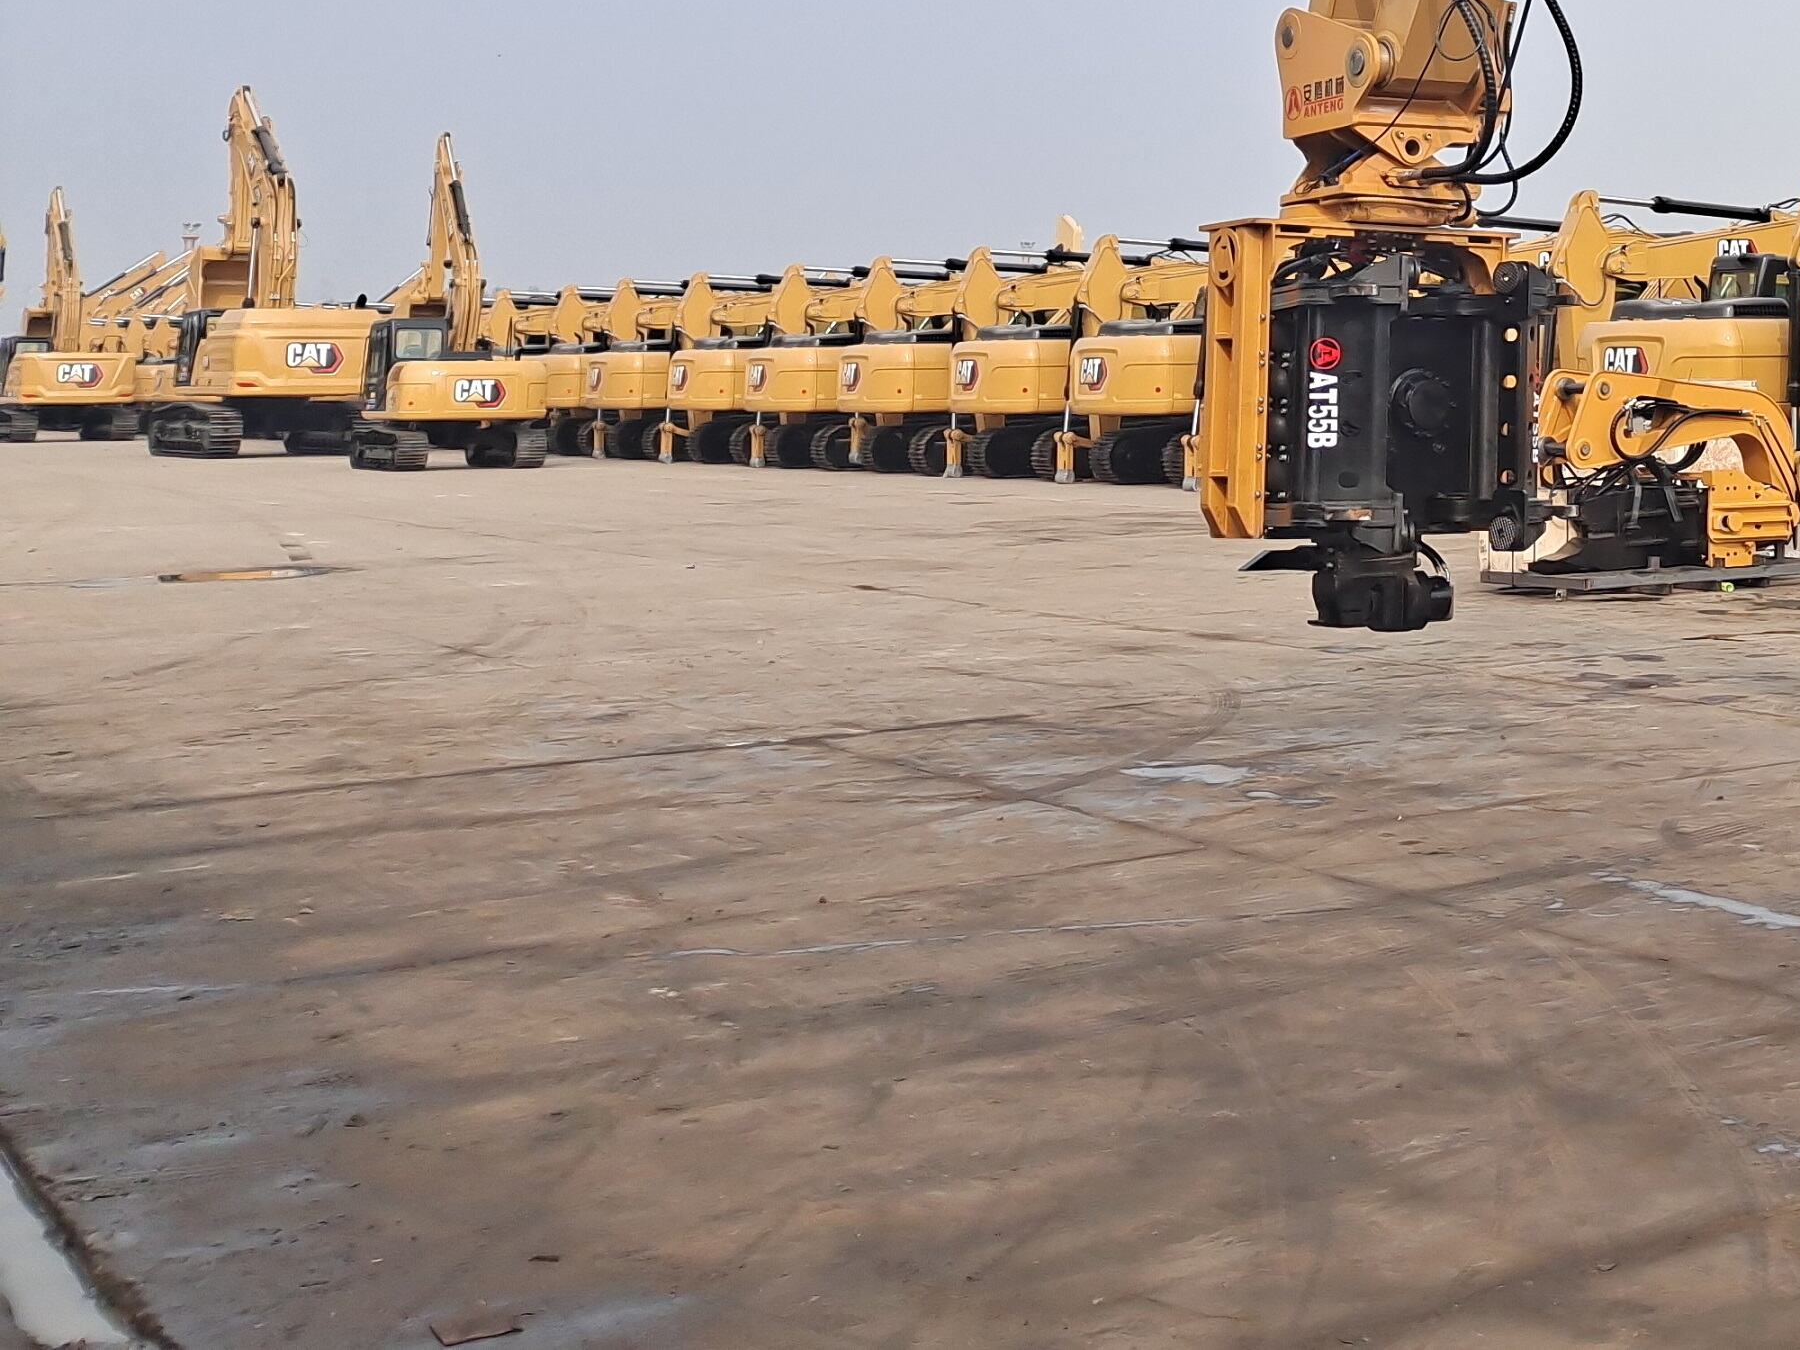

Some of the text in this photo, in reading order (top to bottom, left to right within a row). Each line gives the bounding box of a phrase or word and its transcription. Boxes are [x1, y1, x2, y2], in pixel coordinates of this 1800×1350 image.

[1304, 98, 1344, 118] ANTENG
[1718, 239, 1750, 257] CAT
[287, 343, 330, 367] CAT
[1605, 348, 1638, 373] CAT
[57, 364, 94, 383] CAT
[454, 379, 496, 402] CAT
[1307, 371, 1339, 448] AT55B
